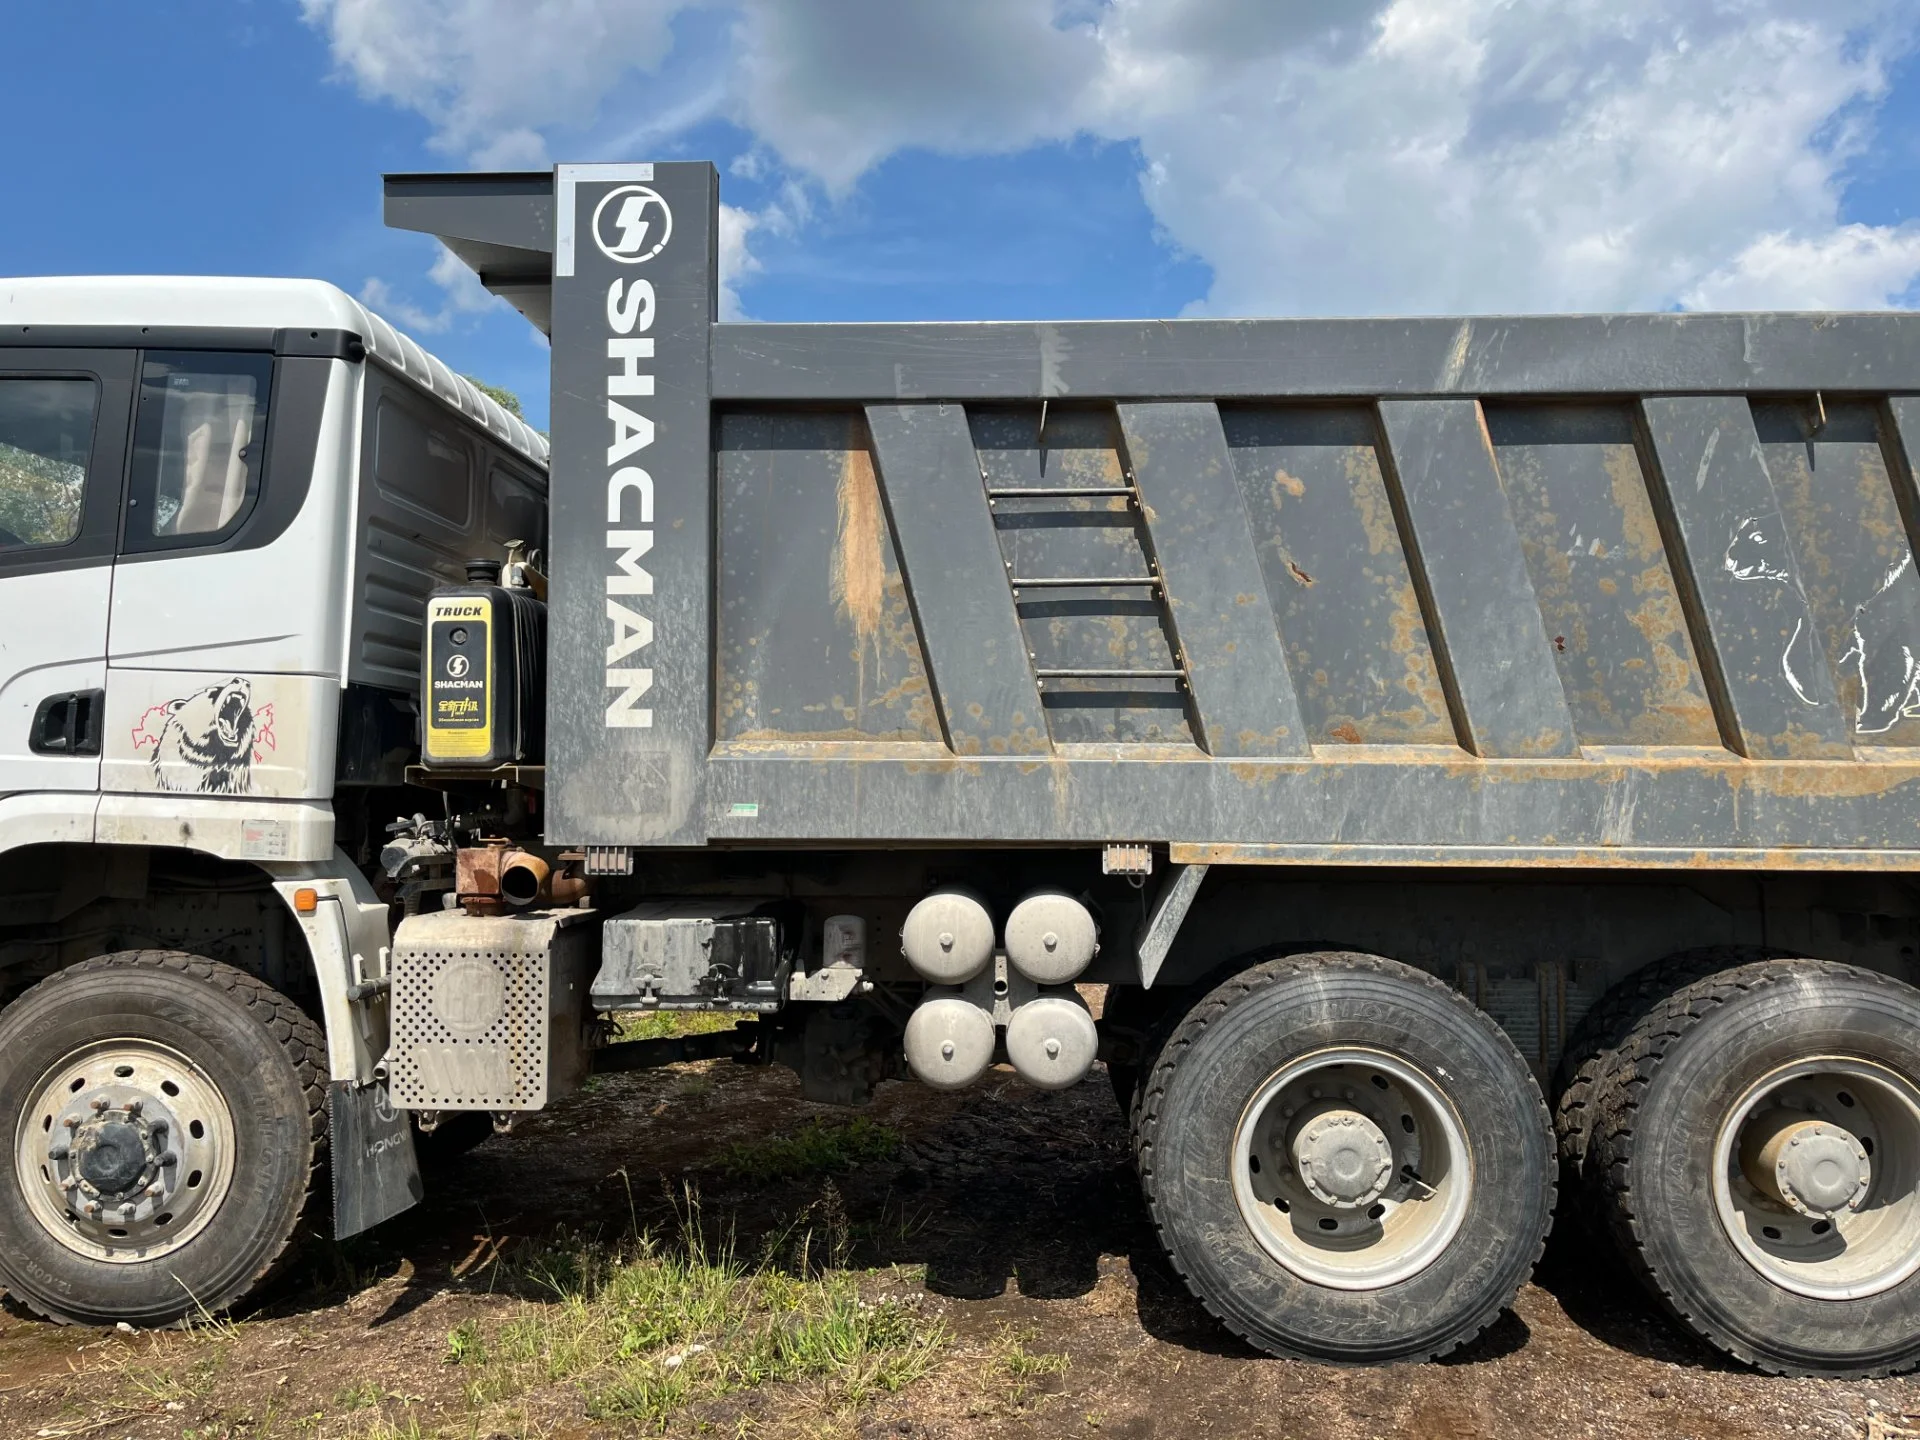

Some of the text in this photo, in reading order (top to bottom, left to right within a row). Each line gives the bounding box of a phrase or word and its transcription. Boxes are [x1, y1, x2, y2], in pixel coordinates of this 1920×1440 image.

[605, 277, 657, 729] SHACMAN
[435, 606, 484, 617] TRUCK
[434, 680, 484, 689] SHACMAN
